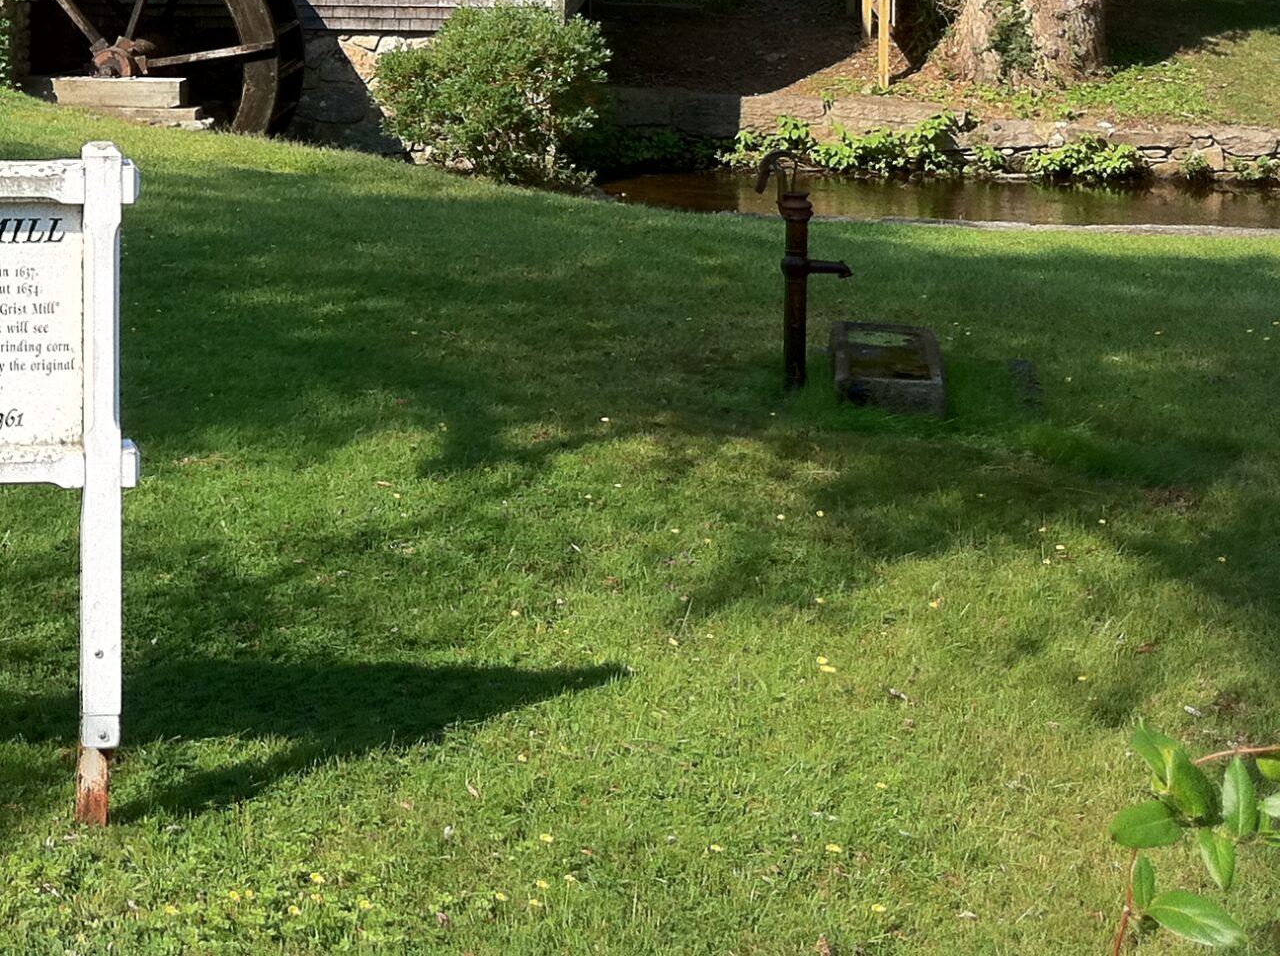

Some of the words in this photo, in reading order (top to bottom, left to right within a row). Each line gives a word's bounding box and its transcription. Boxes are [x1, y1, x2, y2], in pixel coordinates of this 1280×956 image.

[0, 301, 27, 315] Grist
[7, 321, 29, 333] will
[33, 323, 49, 333] see
[10, 358, 26, 370] the
[30, 358, 75, 375] original
